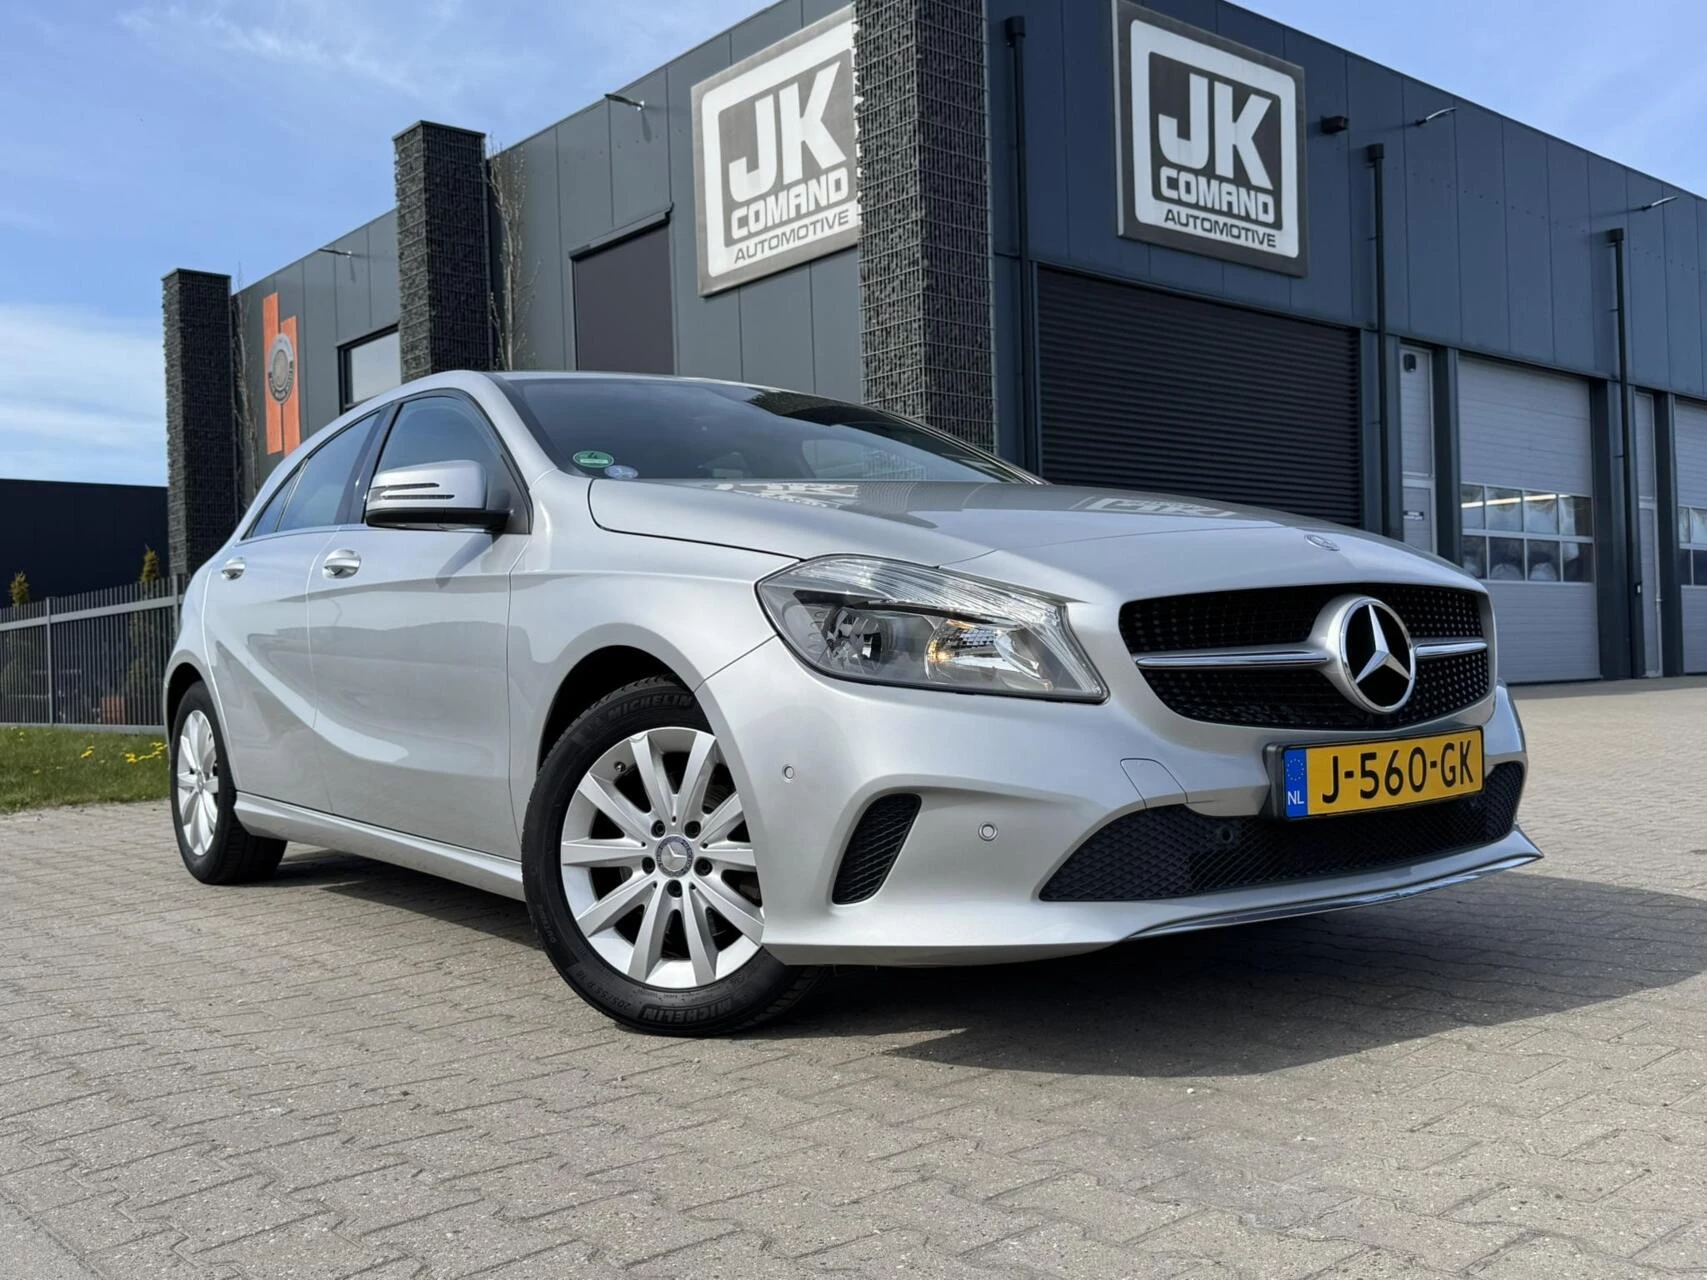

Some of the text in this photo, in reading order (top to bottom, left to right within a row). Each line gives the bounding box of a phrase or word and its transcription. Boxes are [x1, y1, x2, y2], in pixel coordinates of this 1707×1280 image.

[728, 61, 847, 203] JK
[1158, 72, 1273, 190] JK
[731, 166, 848, 240] COMAND
[1160, 166, 1275, 224] COMAND
[734, 209, 849, 264] AUTOMOTIVE
[1164, 208, 1276, 248] AUTOMOTIVE
[607, 694, 693, 721] MICHELIN
[1287, 790, 1305, 805] NL
[1322, 740, 1474, 804] J-560-GK
[640, 998, 732, 1024] MICHELIN
